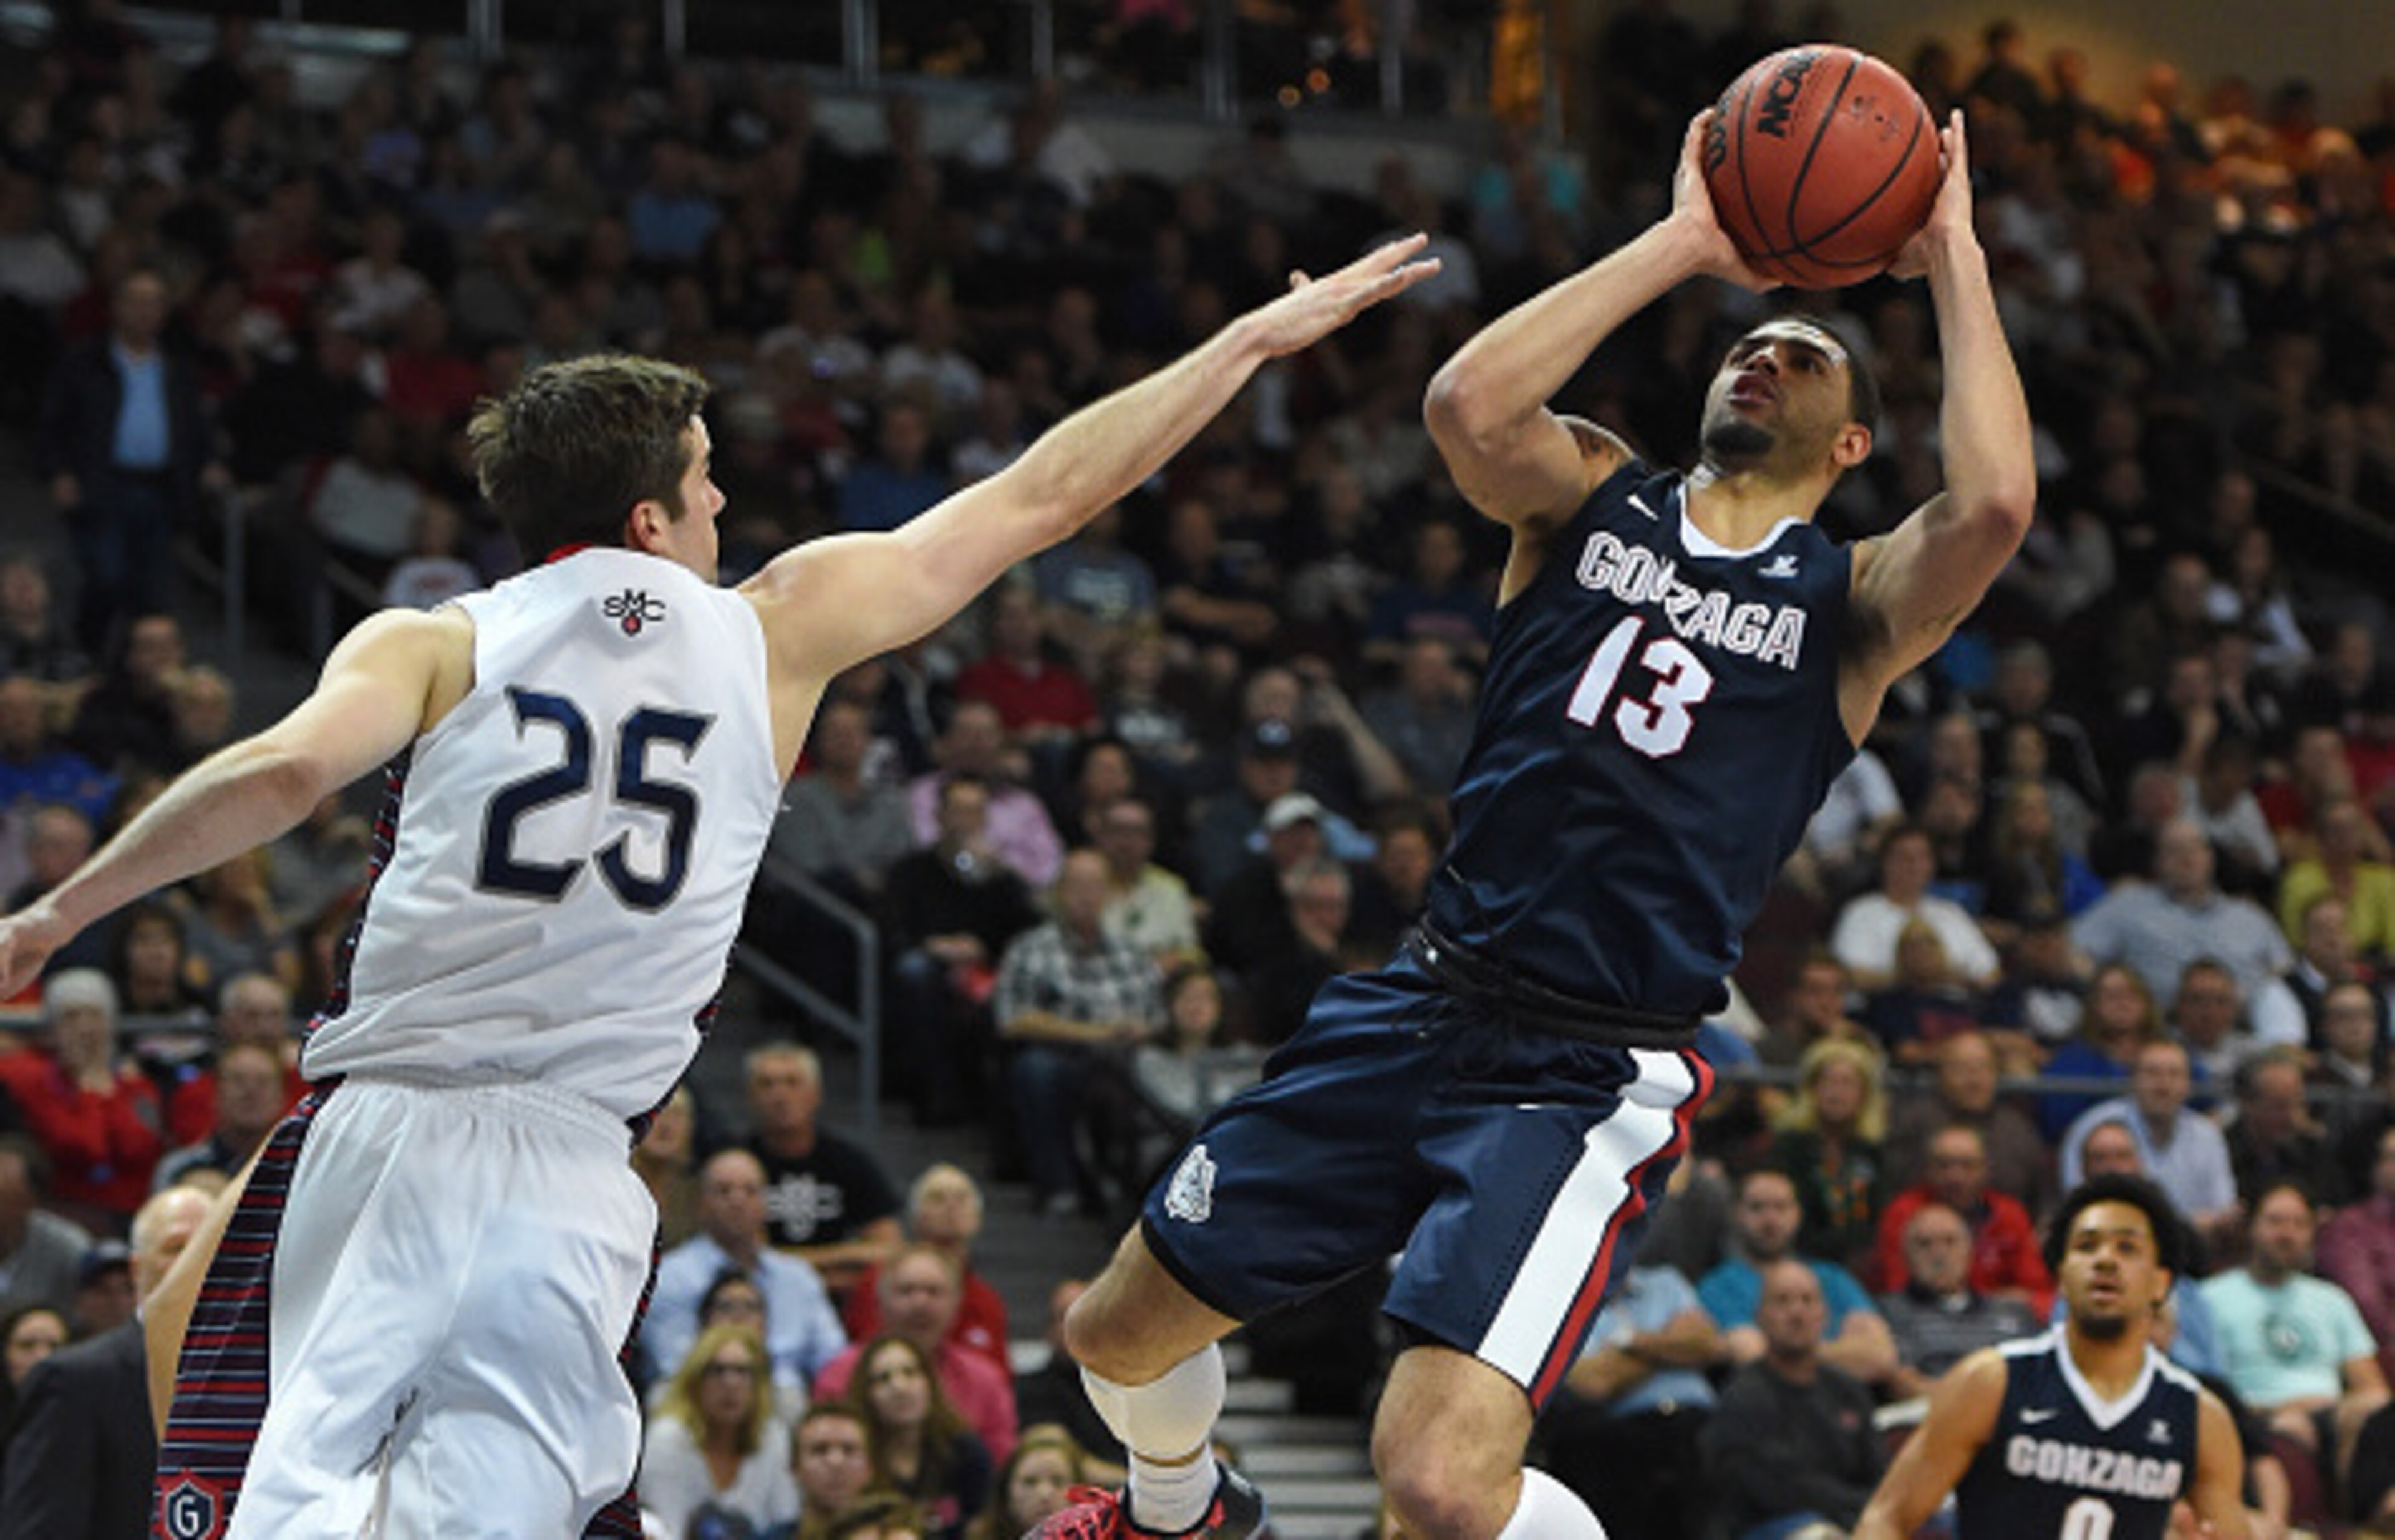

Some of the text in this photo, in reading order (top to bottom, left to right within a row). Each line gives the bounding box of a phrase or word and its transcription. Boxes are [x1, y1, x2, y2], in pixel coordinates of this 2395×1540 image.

[1566, 614, 1715, 758] 13
[472, 684, 718, 915] 25
[173, 1495, 199, 1537] G
[2007, 1433, 2183, 1498] GONZAGA
